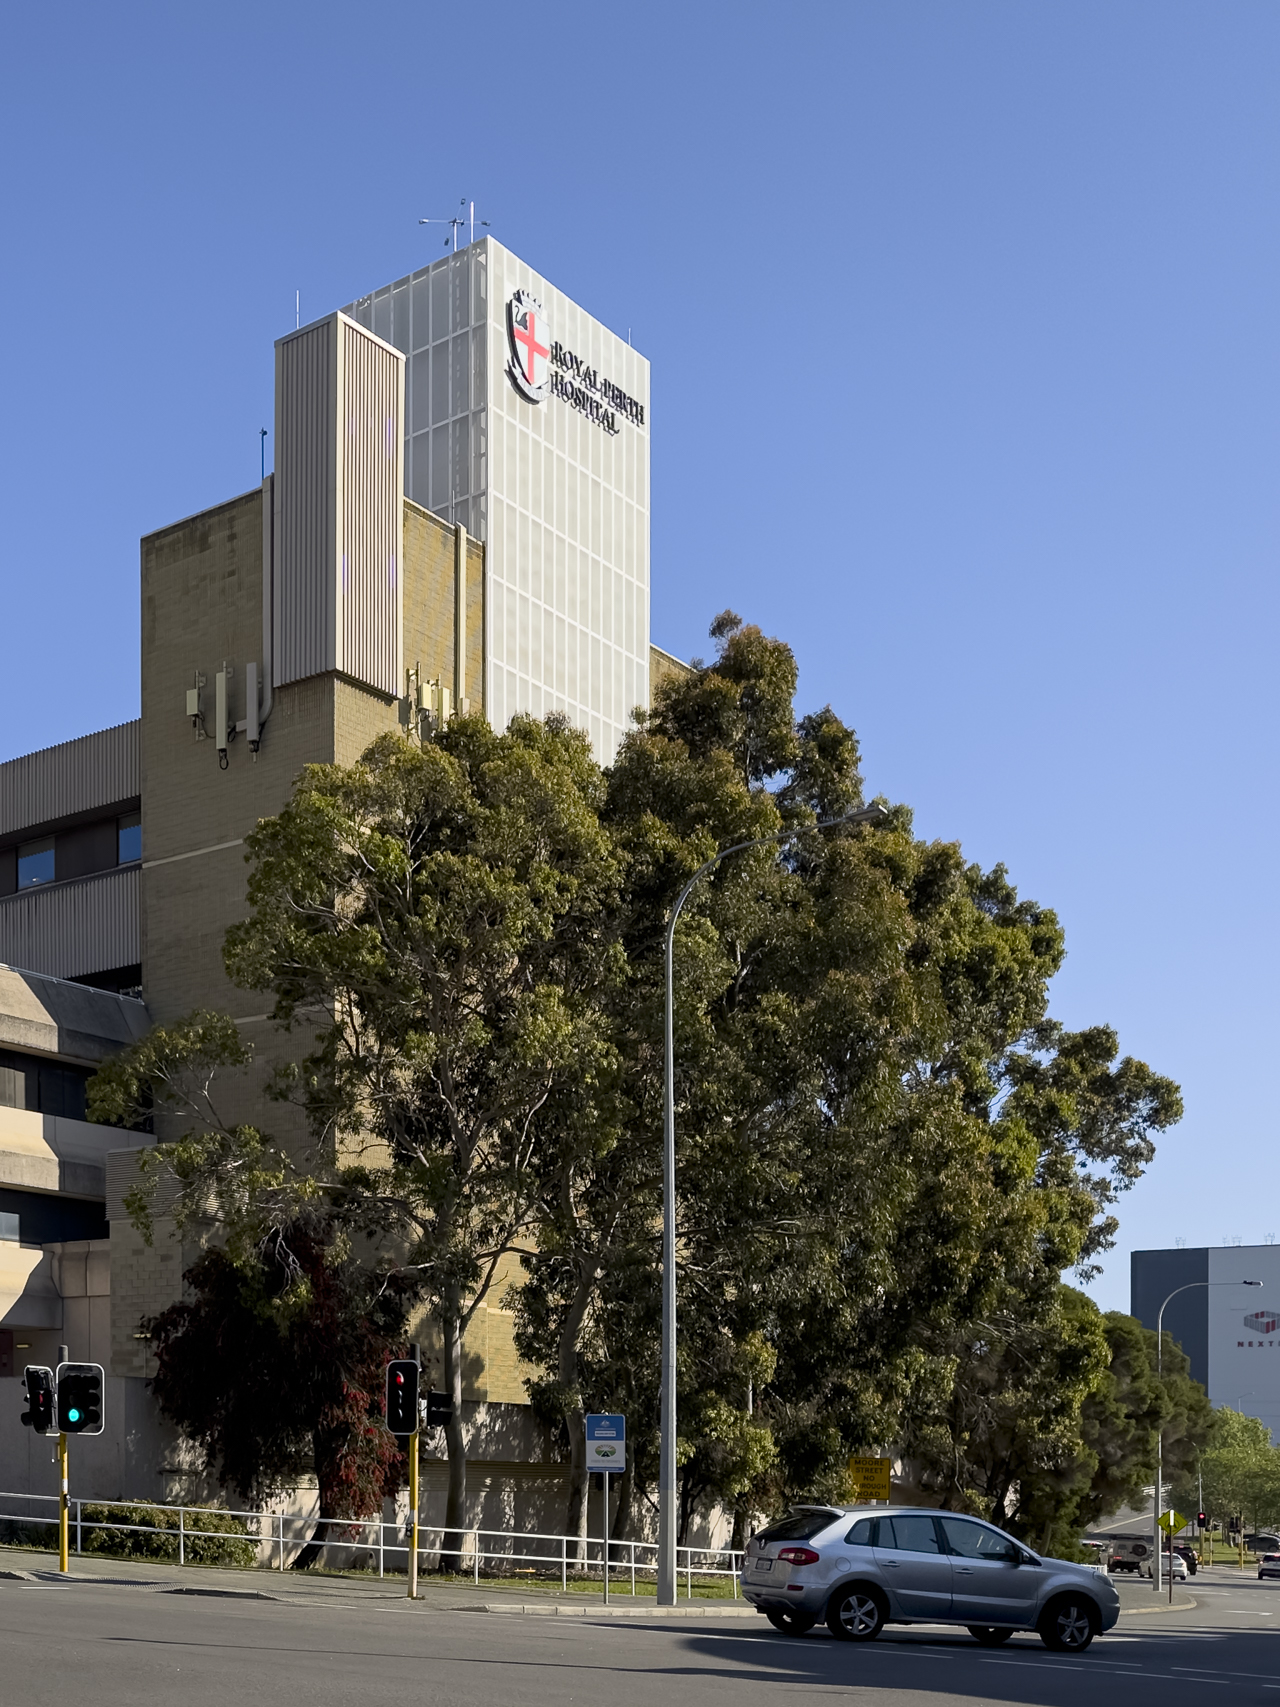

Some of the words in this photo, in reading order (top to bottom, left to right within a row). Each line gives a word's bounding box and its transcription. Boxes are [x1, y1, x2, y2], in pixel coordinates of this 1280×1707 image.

[550, 340, 601, 393] ROYAL
[600, 377, 645, 427] PERTH
[550, 370, 620, 437] HOSPITAL
